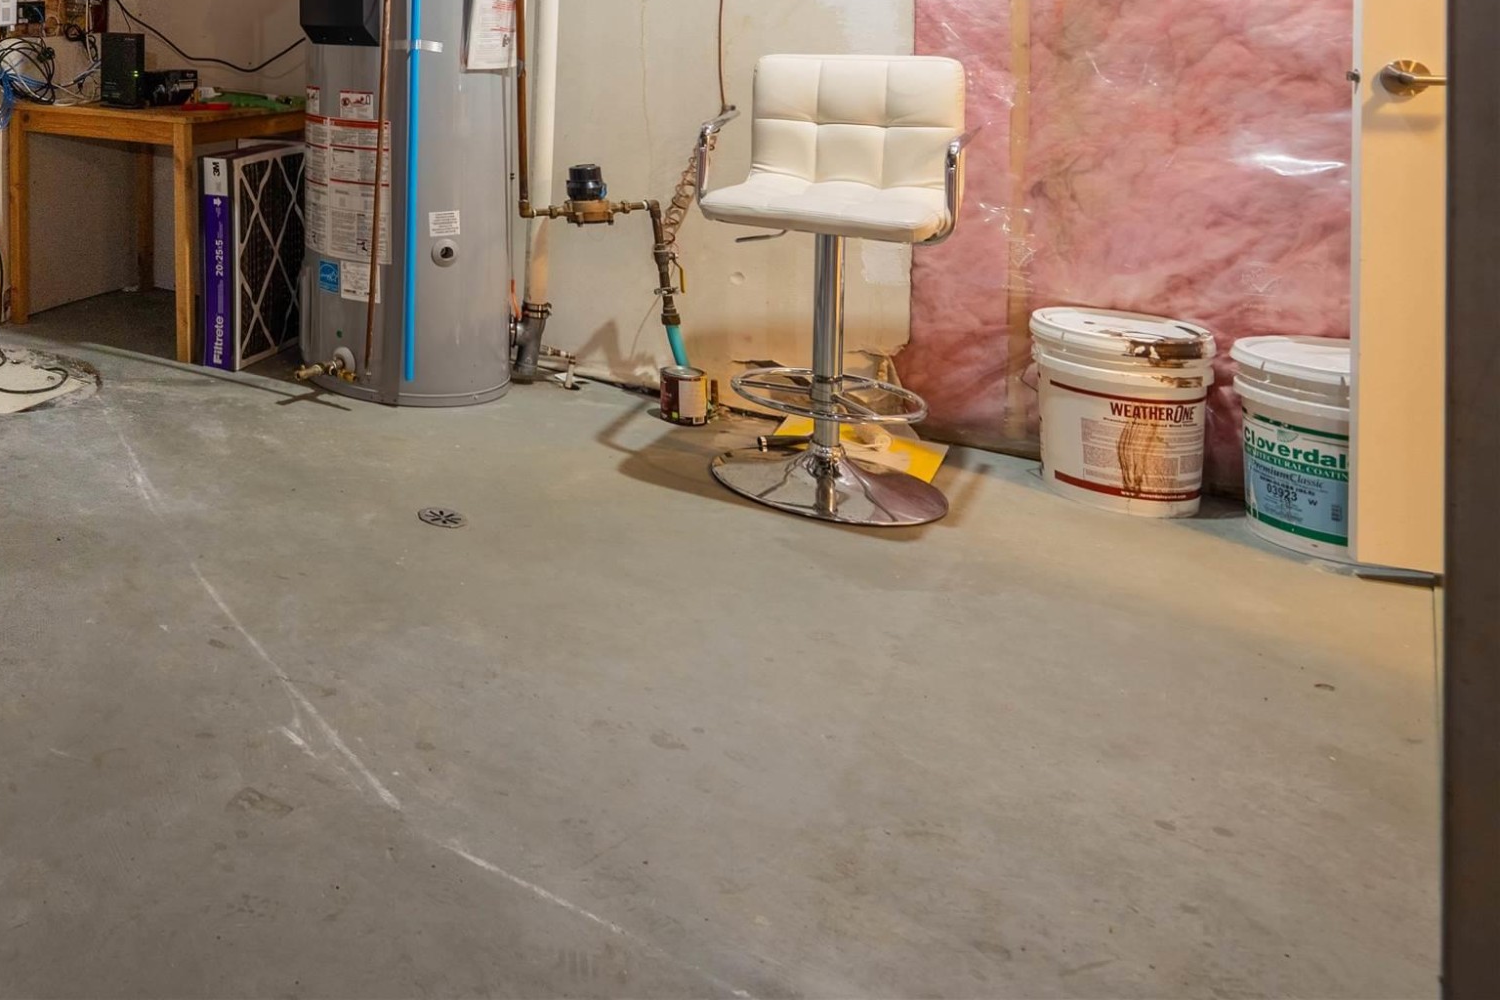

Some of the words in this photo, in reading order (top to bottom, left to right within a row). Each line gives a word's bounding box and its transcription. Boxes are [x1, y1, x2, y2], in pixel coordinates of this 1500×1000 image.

[213, 162, 221, 177] 3M
[213, 315, 225, 364] Filtrete
[1244, 426, 1349, 470] Cloverdal
[1266, 483, 1298, 502] 03923
